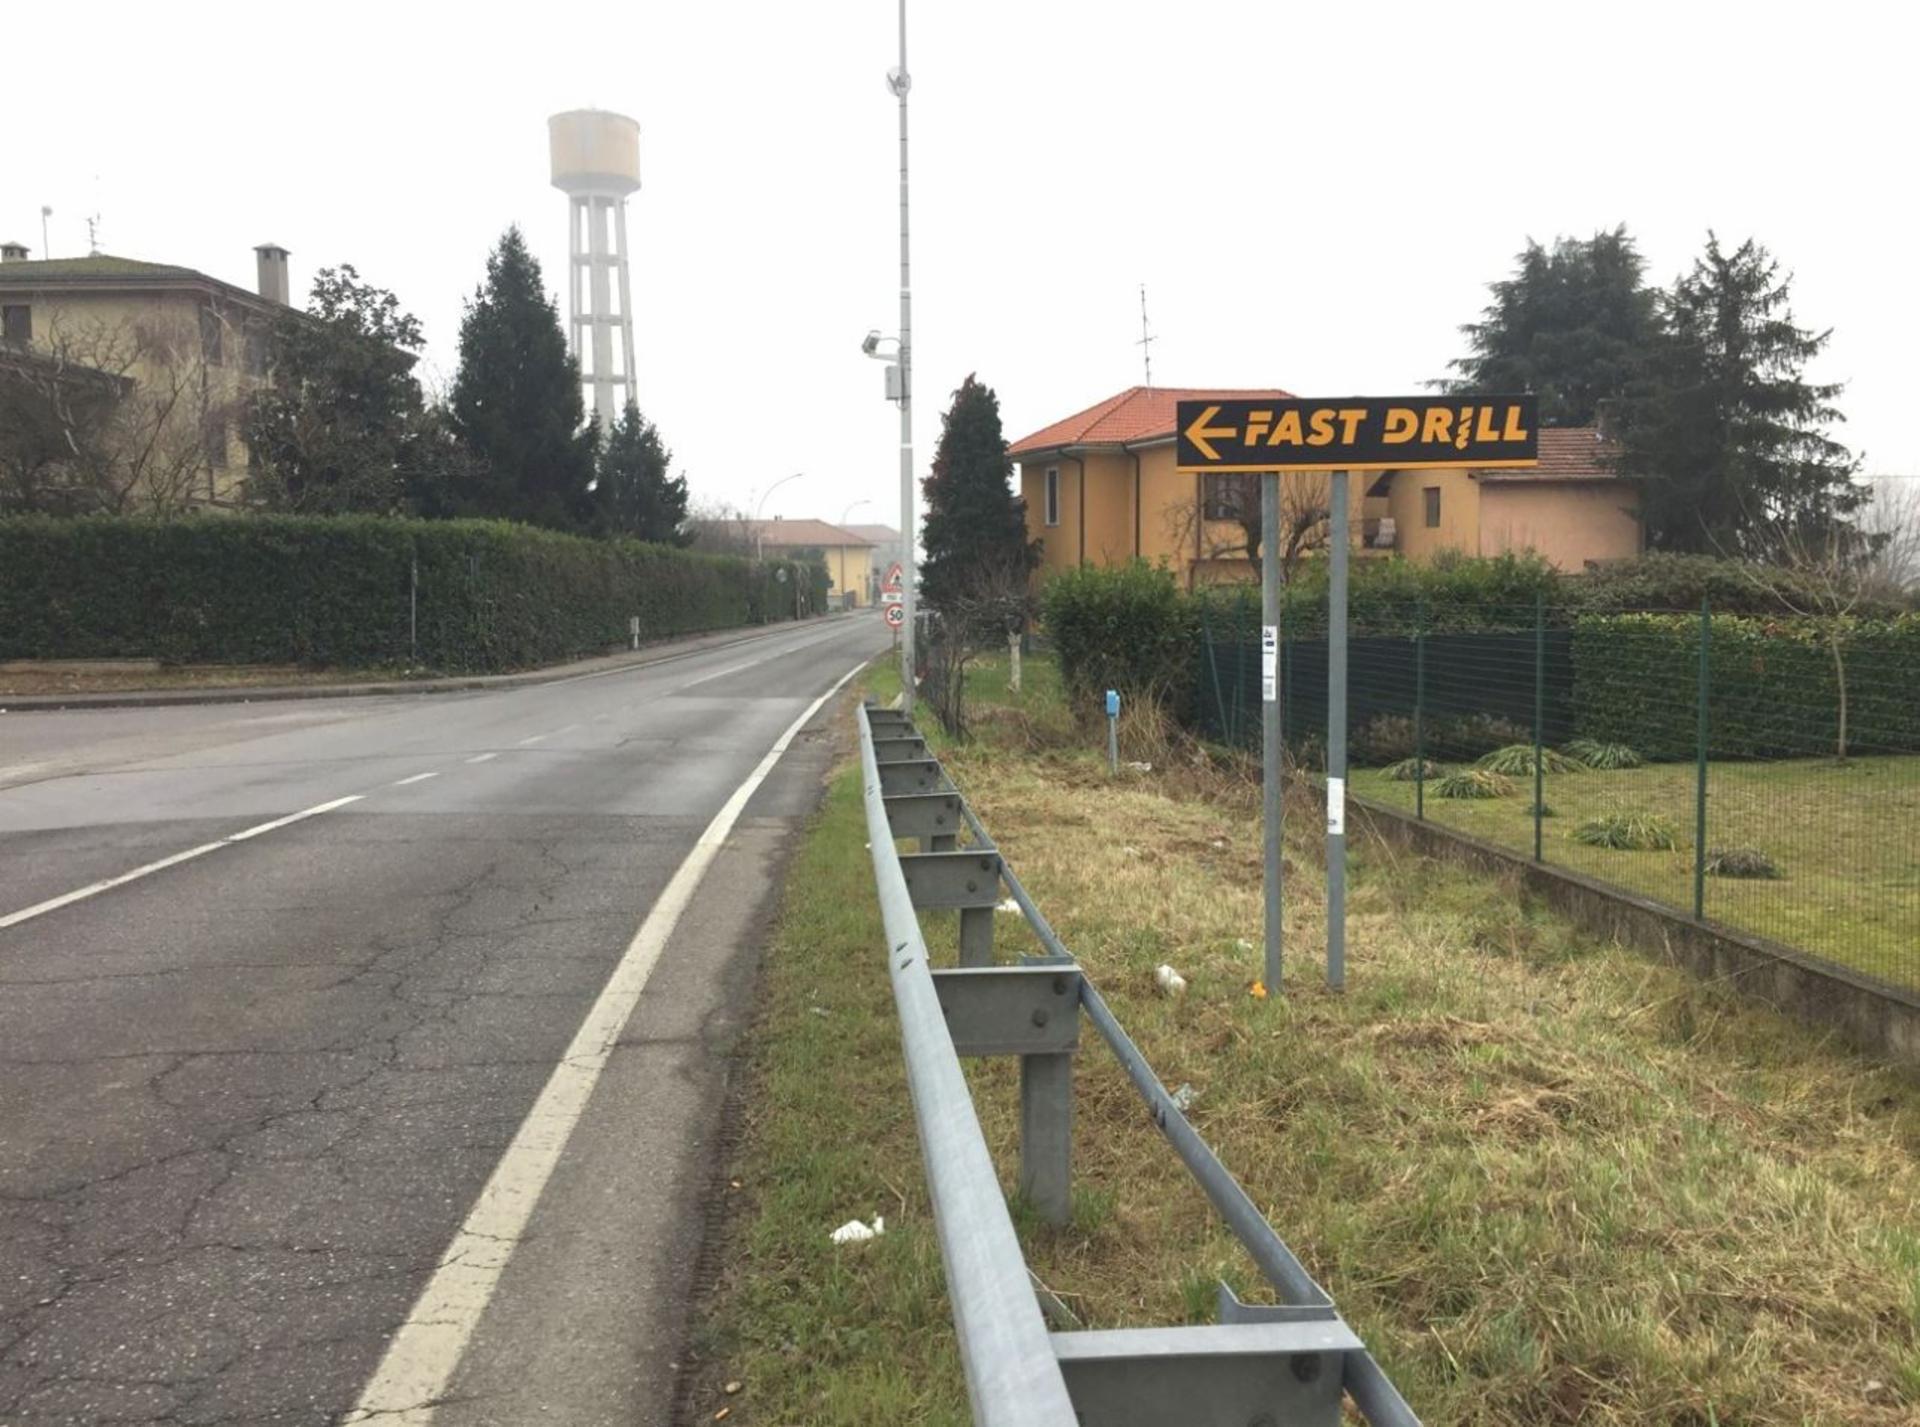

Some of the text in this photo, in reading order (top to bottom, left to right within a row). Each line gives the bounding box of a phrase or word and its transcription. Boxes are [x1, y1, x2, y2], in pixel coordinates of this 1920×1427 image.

[1244, 406, 1528, 450] FAST DRILL
[889, 609, 903, 621] 50
